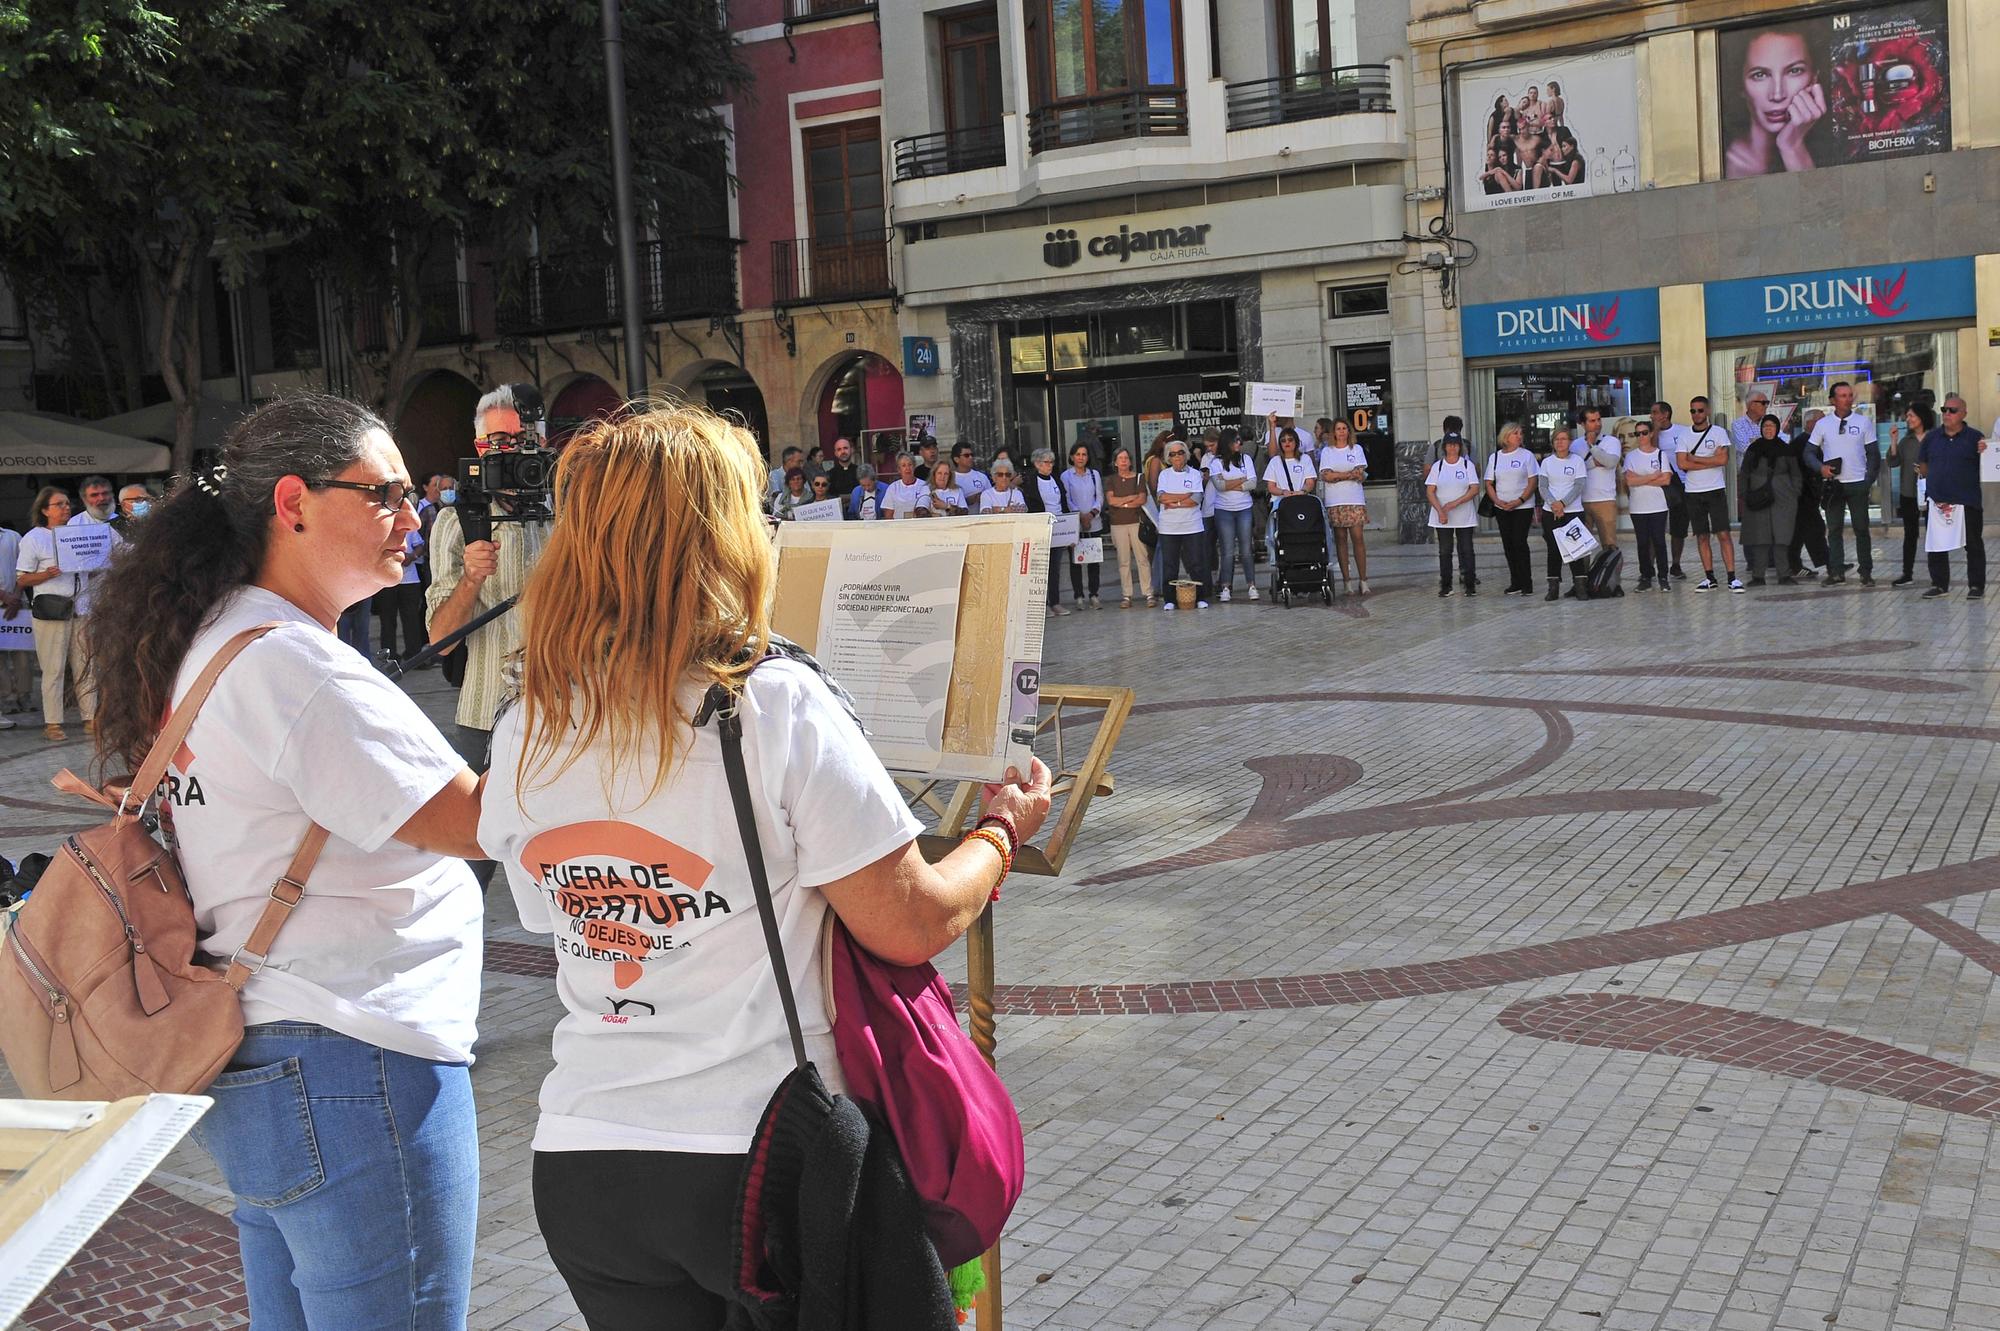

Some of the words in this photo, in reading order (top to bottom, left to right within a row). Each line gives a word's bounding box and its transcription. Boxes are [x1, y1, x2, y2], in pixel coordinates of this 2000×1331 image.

[1869, 136, 1915, 150] BIOTHERM
[1495, 198, 1512, 206] LOVE
[1551, 191, 1561, 199] OF
[1088, 224, 1212, 263] cajamar
[1150, 251, 1175, 262] CAJA
[1178, 247, 1211, 259] RURAL
[1764, 275, 1873, 314] DRUNI
[1497, 303, 1591, 338] DRUNI
[1767, 310, 1870, 326] PERFUMERIES
[1499, 334, 1589, 348] PERFUMERIES
[1178, 391, 1228, 402] BIENVENIDA
[1180, 409, 1200, 420] TRAE
[1201, 409, 1212, 417] TU
[1187, 416, 1221, 428] LLÉVATE
[60, 535, 88, 543] NOSOTROS
[844, 553, 882, 562] Manifiesto
[840, 583, 882, 592] ¿PODRÍAMOS
[883, 584, 901, 592] VIVIR
[838, 593, 850, 601] SIN
[850, 592, 885, 601] CONEXIÓN
[836, 603, 869, 612] SOCIEDAD
[869, 604, 934, 614] HIPERCONECTADA?
[539, 863, 628, 890] FUERA
[630, 863, 673, 889] DE
[569, 918, 586, 936] NO
[588, 924, 637, 947] DEJES
[640, 935, 674, 950] QUE
